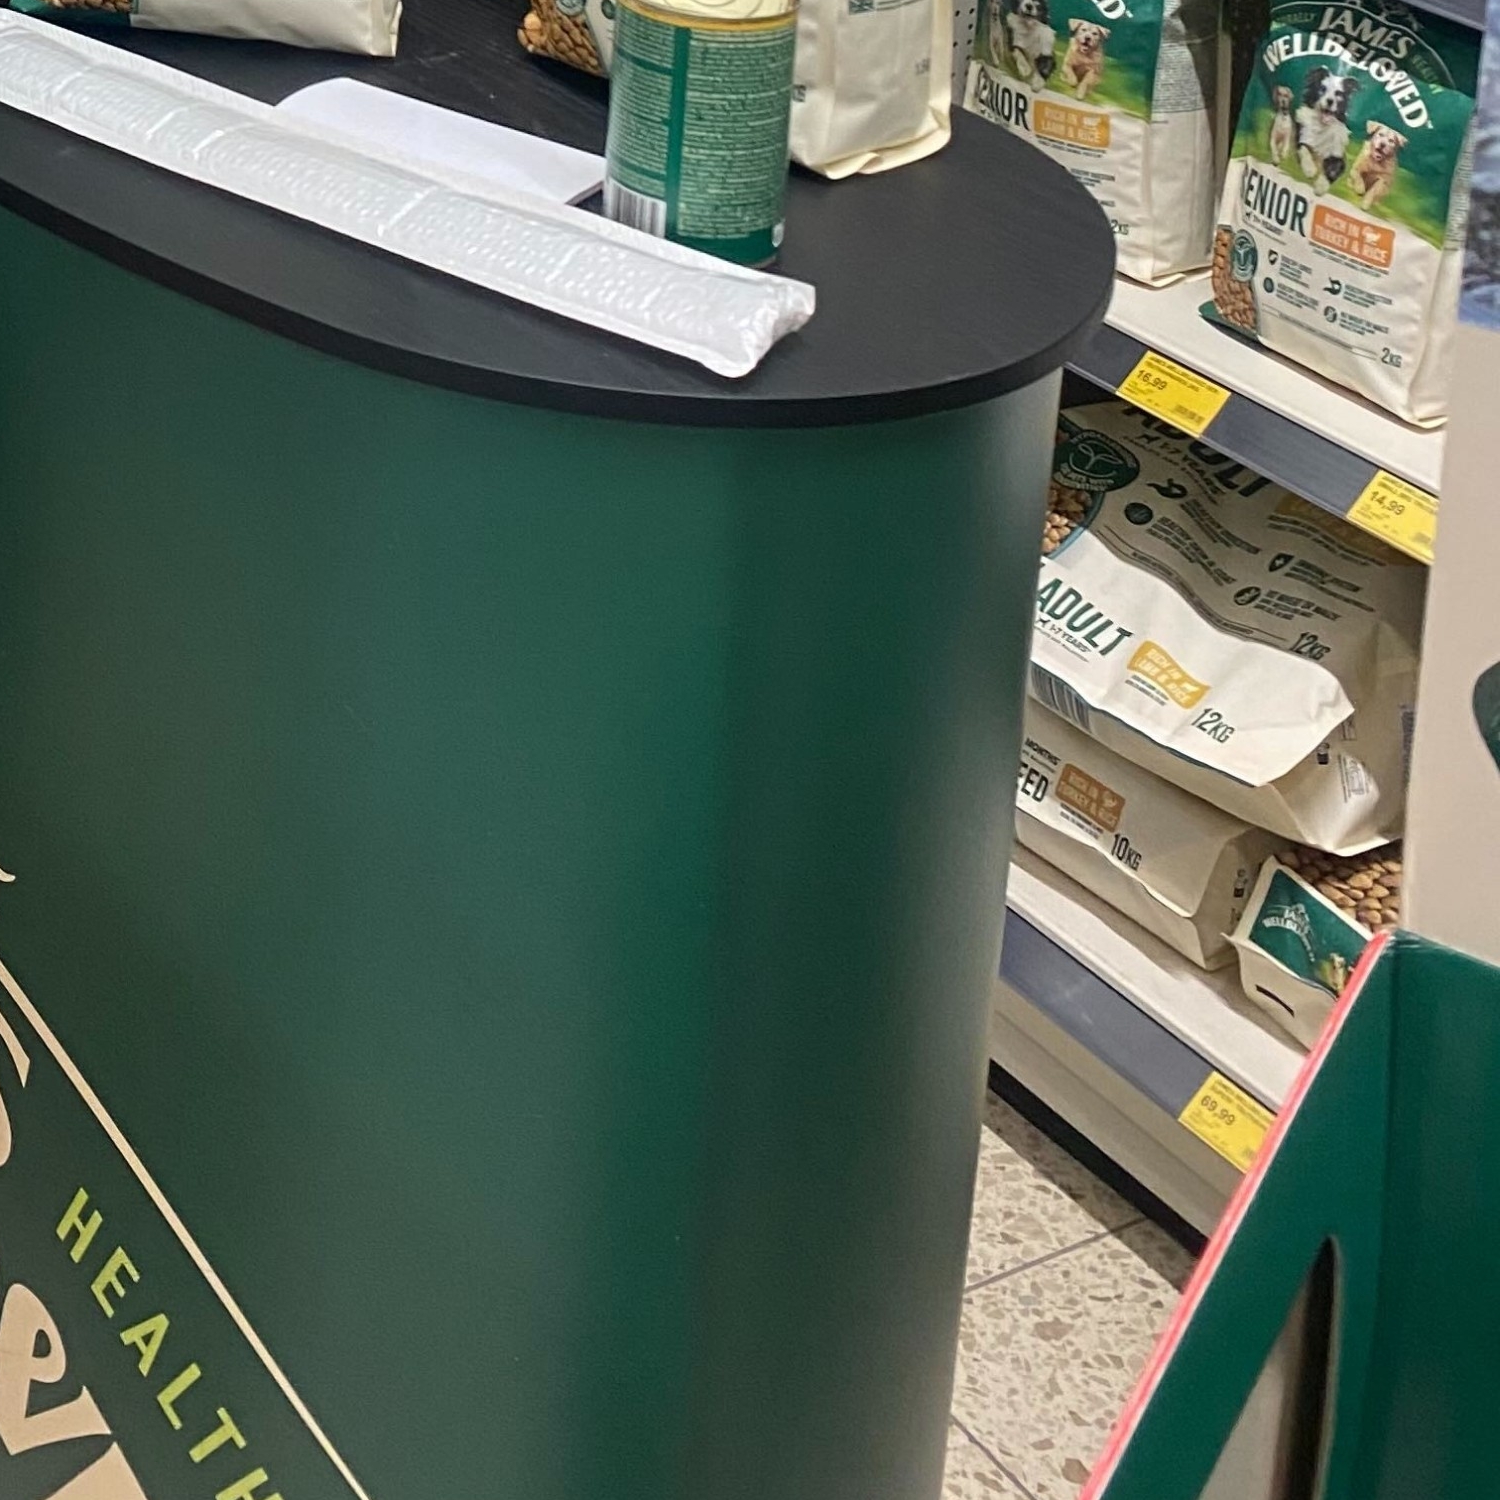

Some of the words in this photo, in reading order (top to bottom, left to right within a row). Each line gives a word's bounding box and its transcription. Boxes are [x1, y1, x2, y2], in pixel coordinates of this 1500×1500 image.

[1318, 6, 1416, 59] JAMES
[1244, 163, 1308, 238] ENIOR
[1370, 491, 1406, 516] 14,99
[1037, 577, 1134, 657] ADULT
[1191, 707, 1236, 744] 12KG
[1111, 833, 1143, 872] 10KG
[1201, 1095, 1235, 1126] 69,99
[56, 1187, 283, 1500] HEALTH
